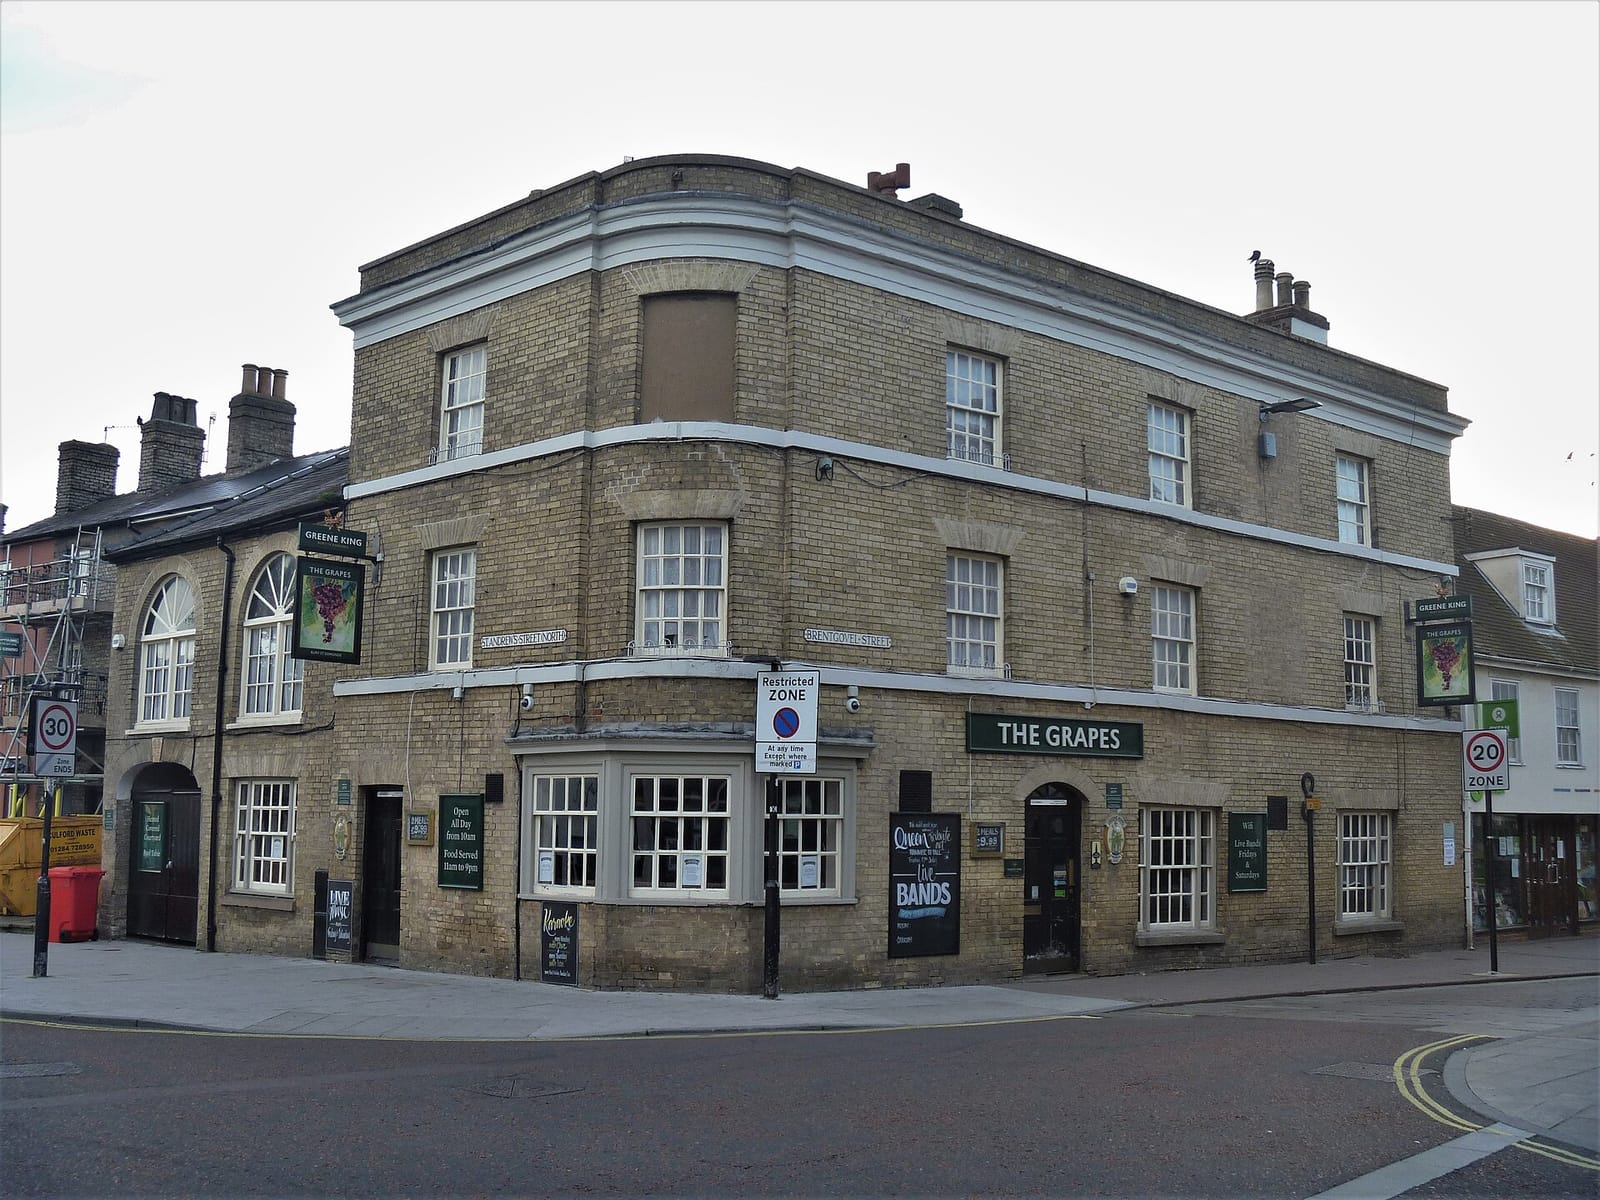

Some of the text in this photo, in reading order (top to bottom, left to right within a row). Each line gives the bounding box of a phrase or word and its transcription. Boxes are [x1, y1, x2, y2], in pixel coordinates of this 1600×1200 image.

[305, 531, 338, 543] GREENE
[341, 537, 362, 546] KING
[325, 569, 351, 578] GRAPES
[1419, 603, 1446, 611] GREENE
[1448, 601, 1466, 609] KING
[519, 632, 540, 645] STREET
[541, 630, 565, 642] NORTH
[806, 630, 889, 646] BRENTGOVEL STREET
[763, 677, 814, 686] Restricted
[769, 690, 806, 701] ZONE
[45, 718, 68, 736] 30
[998, 723, 1121, 749] THE GRAPES
[764, 752, 786, 761] Except
[1473, 744, 1499, 760] 20
[1469, 776, 1504, 787] ZONE
[453, 807, 469, 817] Open
[451, 819, 472, 830] All Day
[76, 829, 96, 837] WASTE
[446, 831, 476, 841] from 10am
[894, 826, 930, 849] Queen
[1234, 839, 1245, 848] Live
[444, 849, 478, 860] Food Served
[1238, 850, 1257, 859] Fridays
[444, 862, 478, 874] 11am to 9pm
[1235, 871, 1260, 880] Saturdays
[329, 889, 350, 906] LIVE
[896, 882, 951, 905] BANDS
